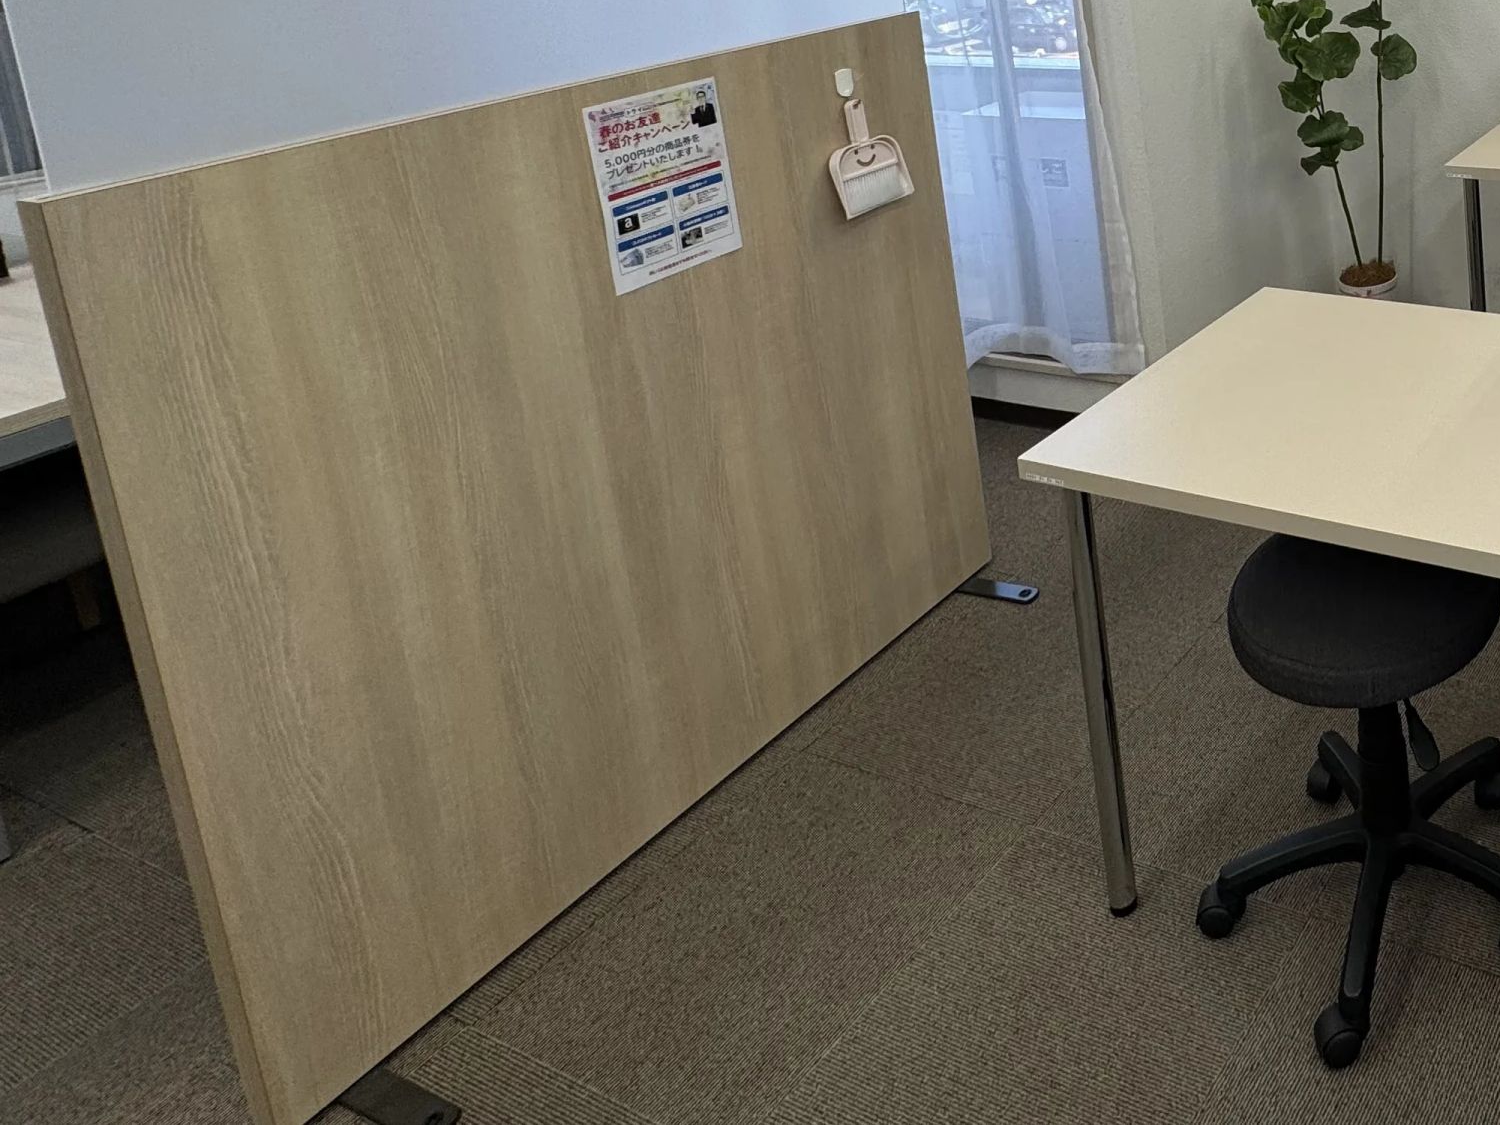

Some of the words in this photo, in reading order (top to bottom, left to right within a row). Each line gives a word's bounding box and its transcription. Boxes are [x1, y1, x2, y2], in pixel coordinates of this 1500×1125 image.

[598, 120, 690, 153] ご紹介キャンペーン
[599, 112, 661, 139] 春のお友達
